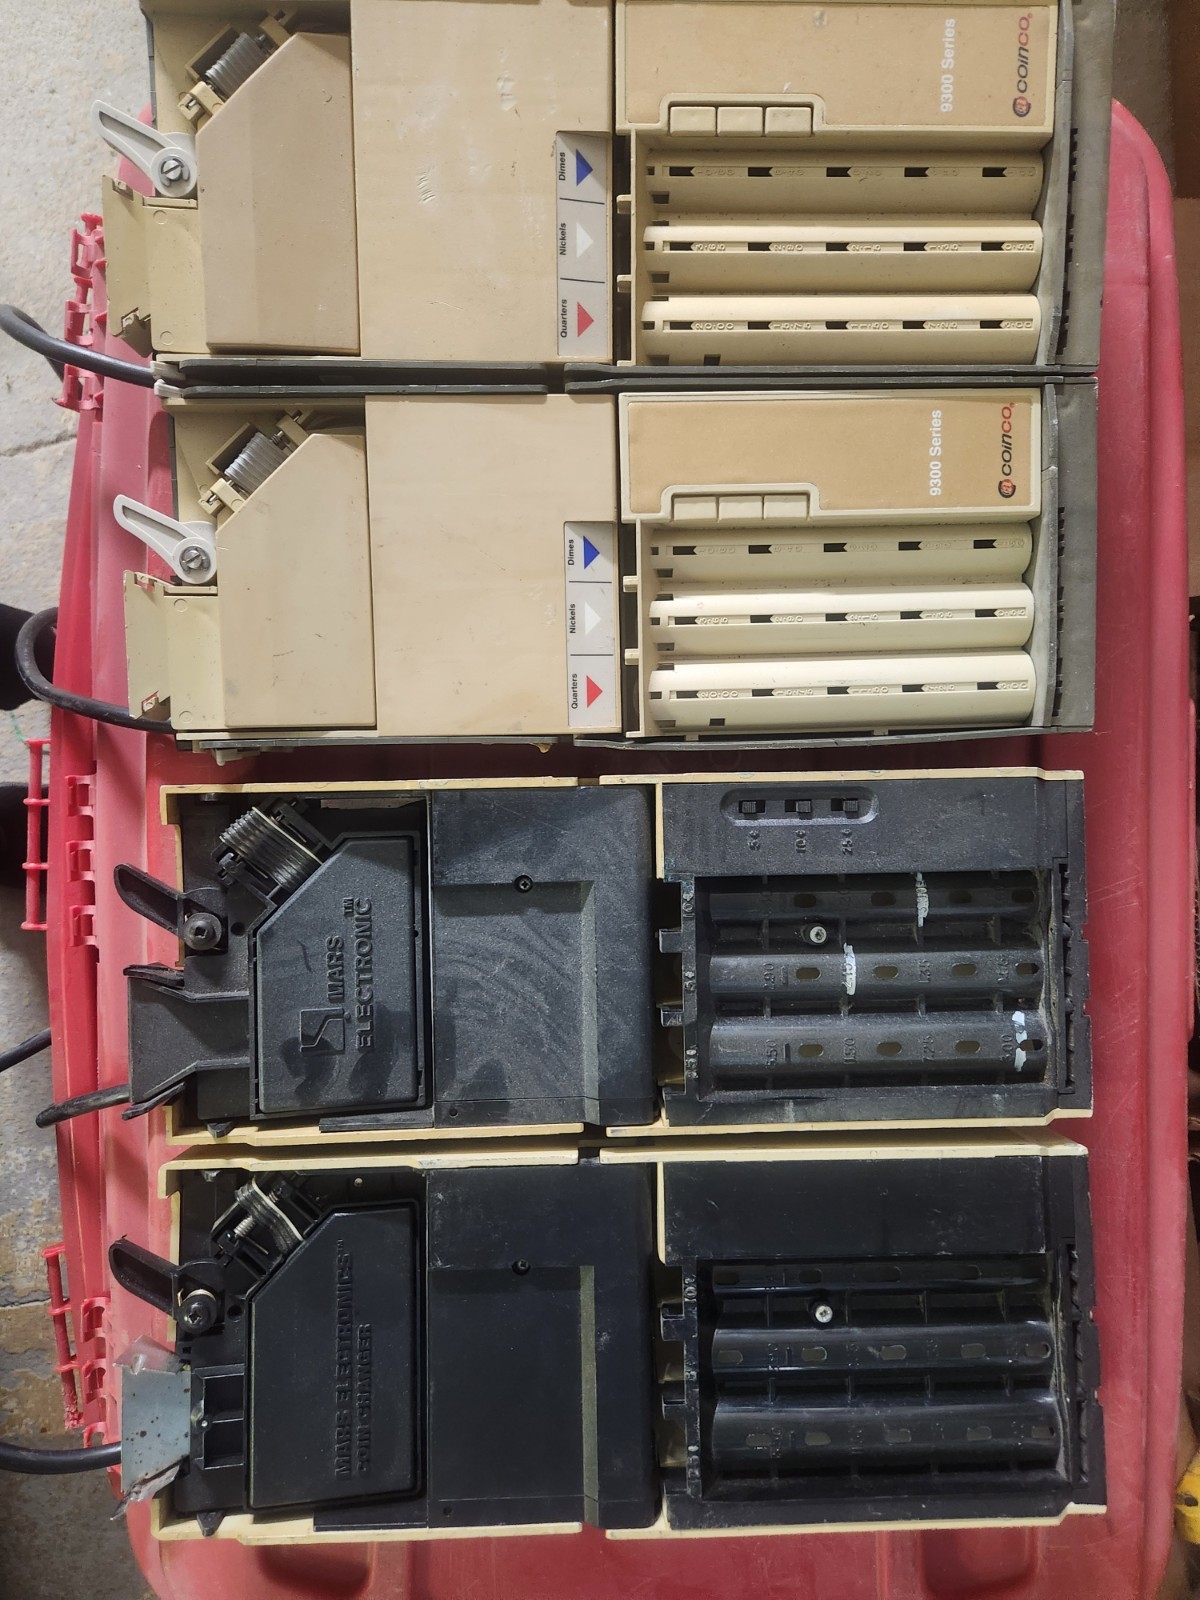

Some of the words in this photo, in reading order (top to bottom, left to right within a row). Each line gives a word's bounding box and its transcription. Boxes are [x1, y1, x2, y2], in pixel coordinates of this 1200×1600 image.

[940, 18, 955, 70] Series
[940, 74, 954, 113] 9300
[558, 152, 566, 181] Dimes
[559, 223, 567, 256] Nickels
[560, 299, 568, 338] Quarters
[929, 409, 942, 456] Series
[929, 461, 942, 496] 9300
[567, 539, 575, 566] Dimes
[568, 603, 576, 634] Nickels
[325, 935, 344, 1003] MARS
[355, 1323, 372, 1423] CHANGER
[334, 1409, 352, 1480] MARS
[355, 1425, 372, 1477] COIN
